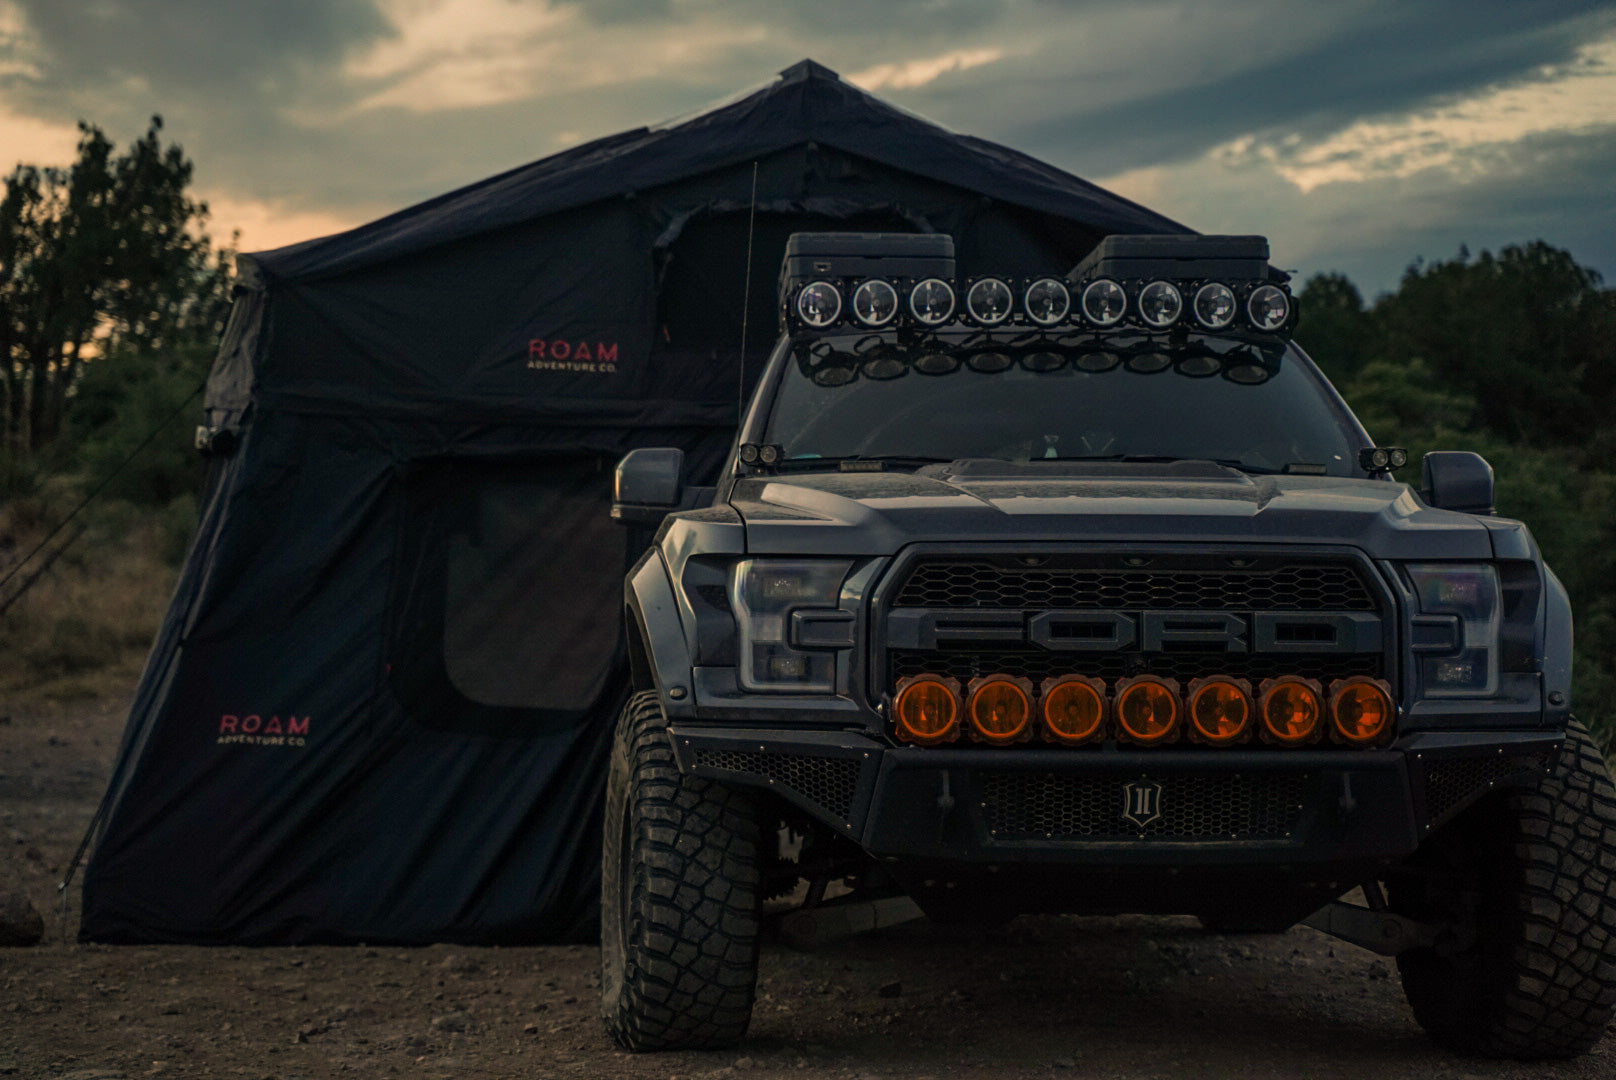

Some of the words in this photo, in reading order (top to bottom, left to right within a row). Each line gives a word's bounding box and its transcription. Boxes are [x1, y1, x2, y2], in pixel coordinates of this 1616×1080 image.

[528, 338, 619, 361] ROAM
[527, 360, 597, 372] ADVENTURE
[893, 608, 1378, 653] FORD
[220, 714, 311, 735] ROAM
